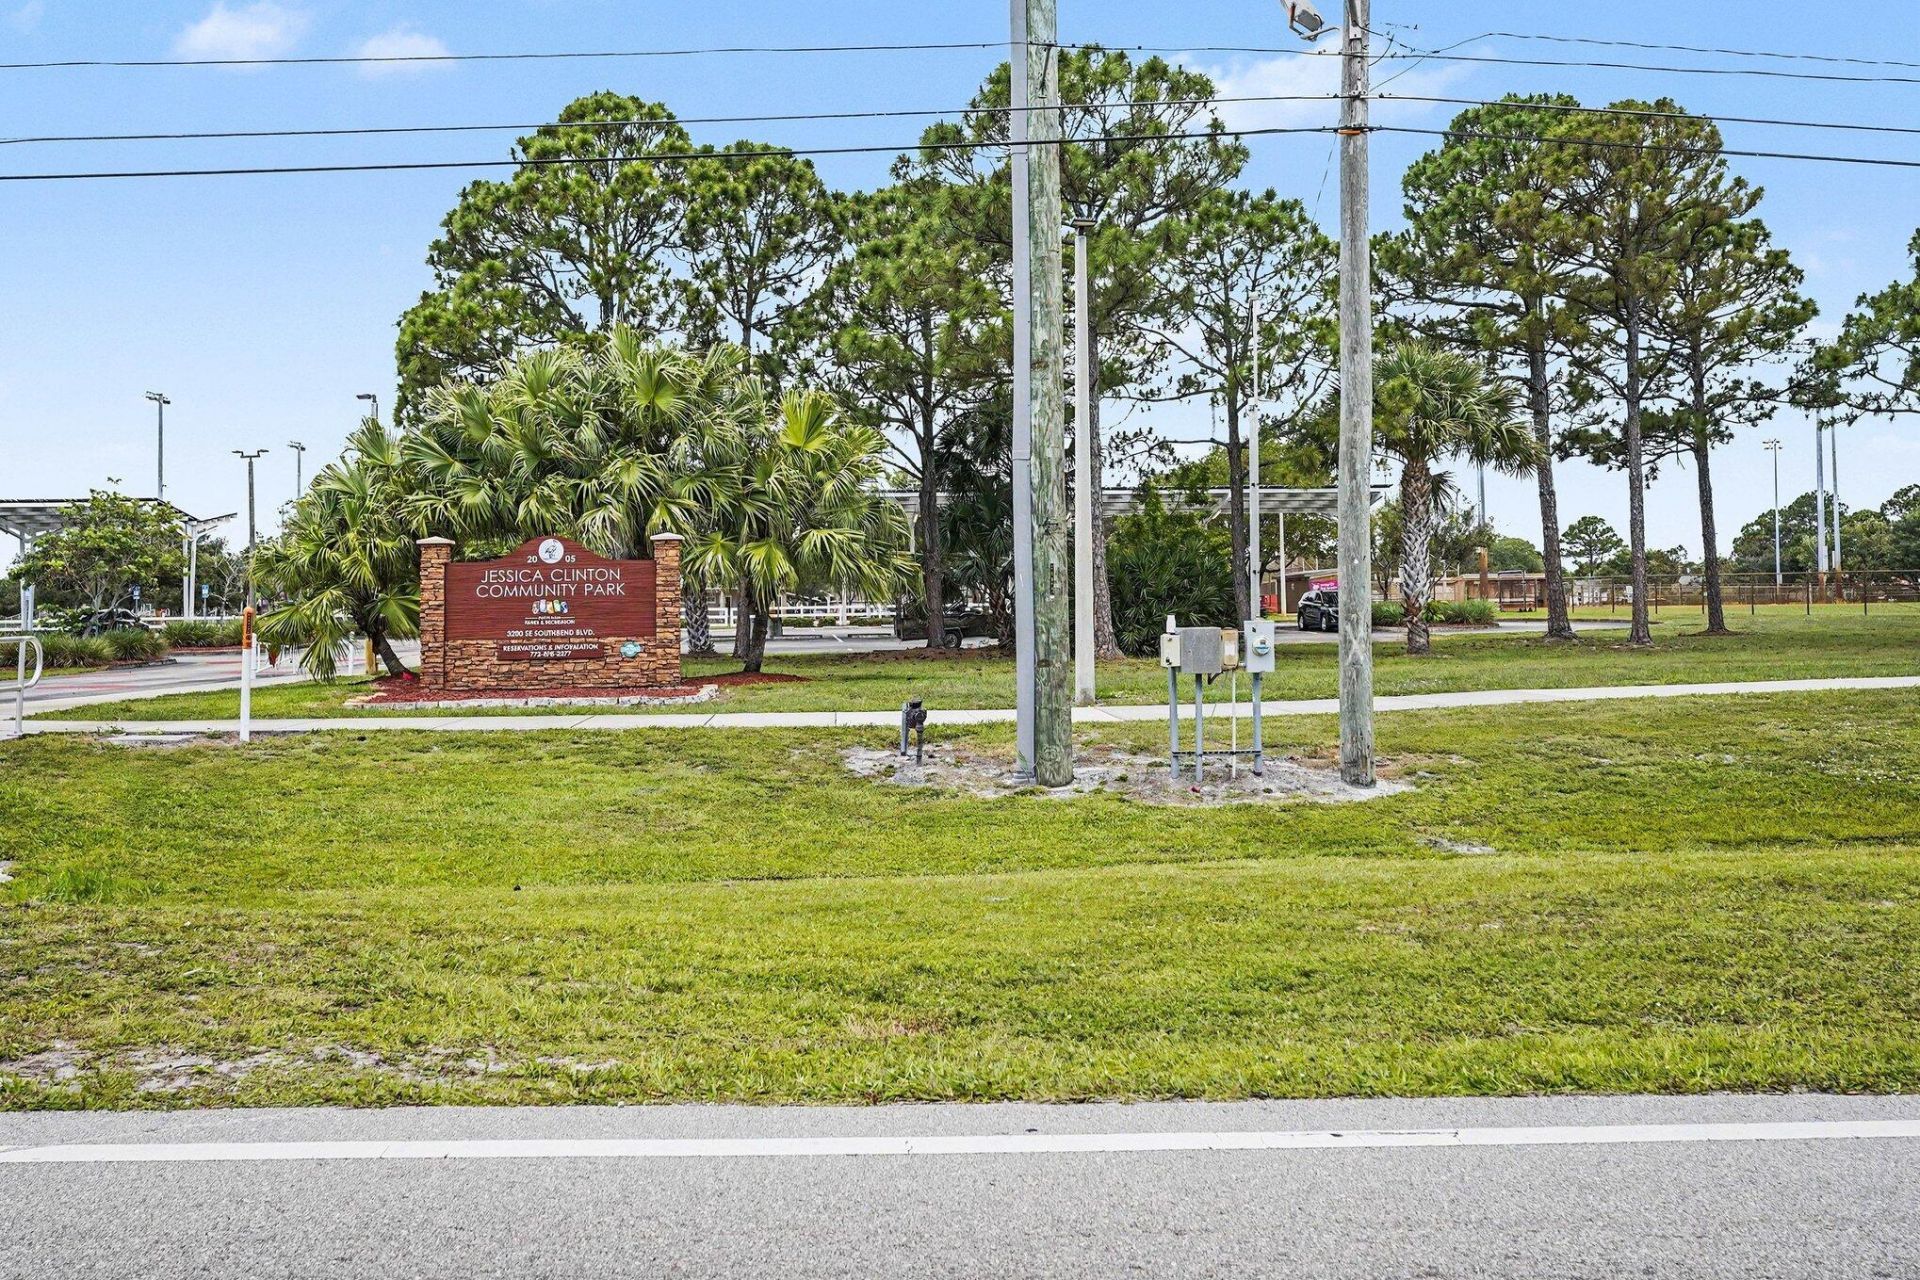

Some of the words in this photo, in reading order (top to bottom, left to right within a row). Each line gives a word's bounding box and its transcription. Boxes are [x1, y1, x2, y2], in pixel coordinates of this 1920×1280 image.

[526, 555, 538, 563] 20
[565, 555, 576, 563] 05
[480, 569, 544, 583] JESSICA
[550, 568, 621, 582] CLINTON
[476, 583, 578, 598] COMMUNITY
[584, 583, 626, 596] PARK
[534, 629, 574, 637] SOUTHBEND
